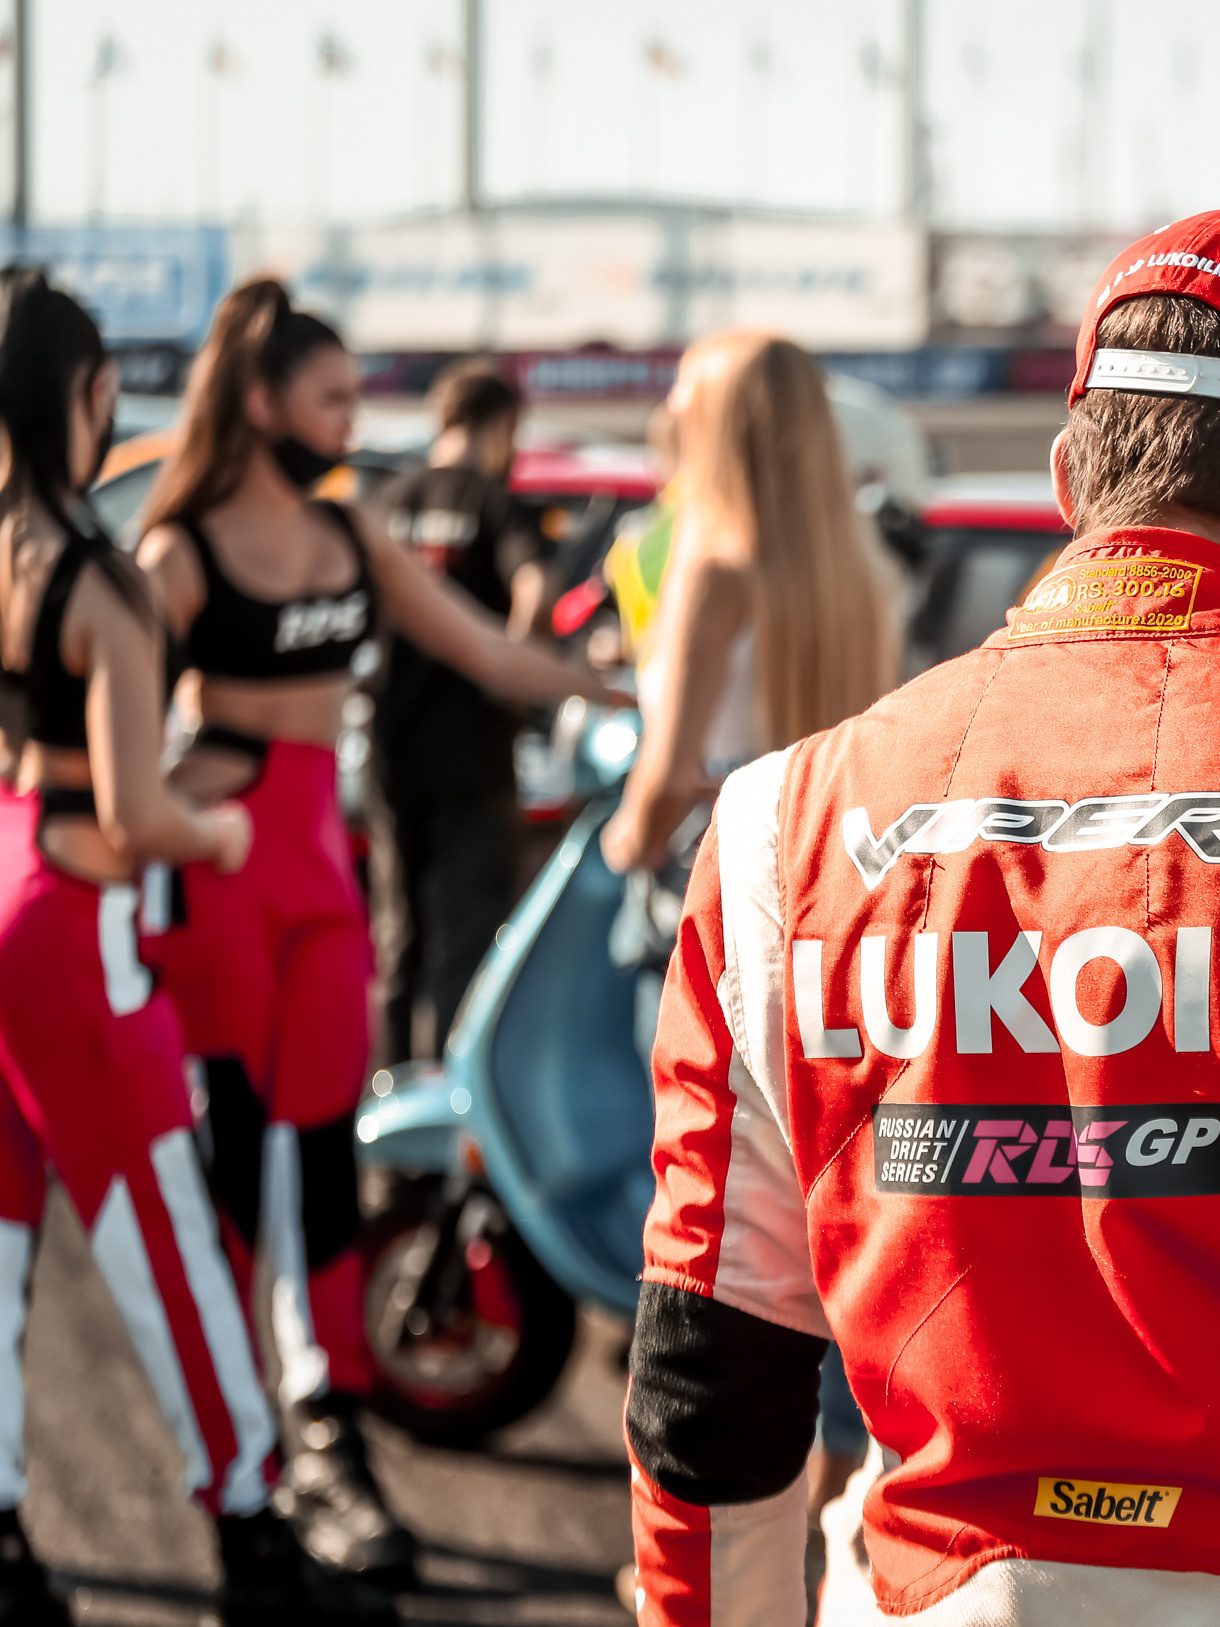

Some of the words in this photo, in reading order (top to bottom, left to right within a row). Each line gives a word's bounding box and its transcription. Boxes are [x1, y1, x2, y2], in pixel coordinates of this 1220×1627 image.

[1079, 566, 1128, 580] Standard
[1129, 566, 1193, 580] 8856-2000
[1015, 619, 1041, 633] Year
[1041, 618, 1055, 630] of
[878, 1118, 956, 1139] RUSSIAN
[890, 1141, 948, 1161] DRIFT
[881, 1162, 938, 1184] SERIES
[1050, 1481, 1164, 1524] Sabelt
